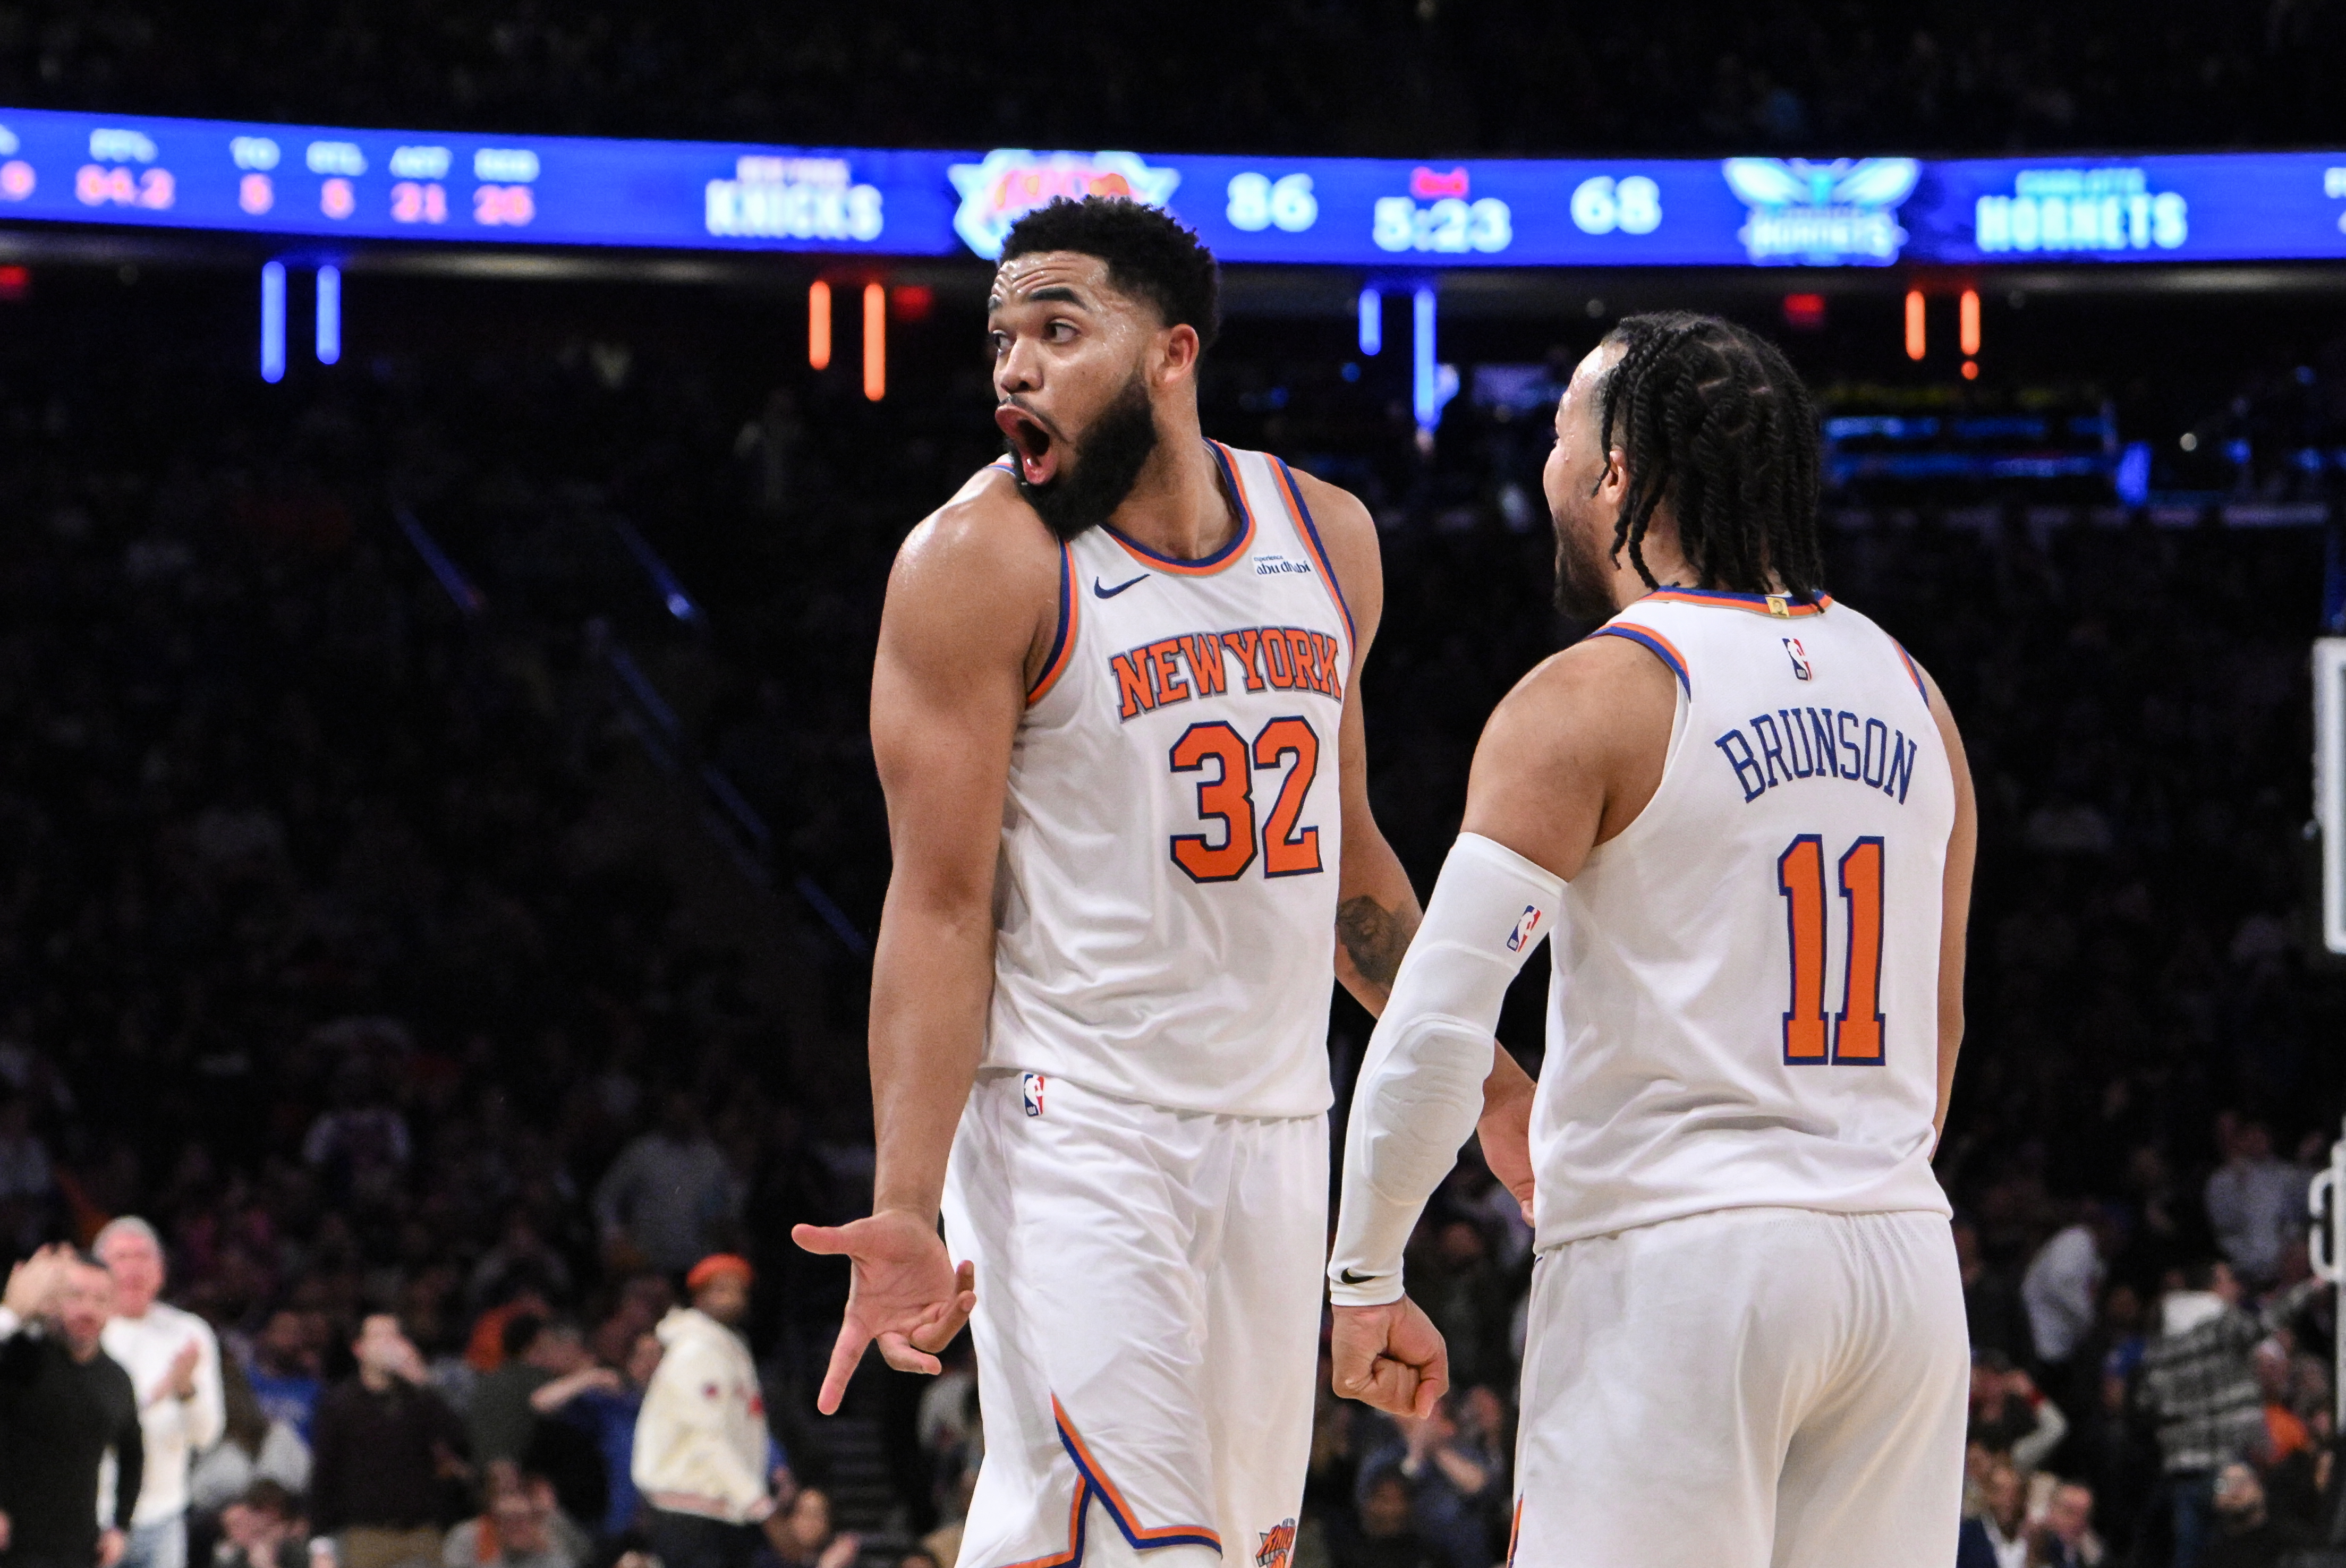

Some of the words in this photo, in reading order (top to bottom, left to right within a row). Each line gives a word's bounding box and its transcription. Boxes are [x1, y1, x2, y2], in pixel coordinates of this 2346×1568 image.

[706, 178, 882, 242] KNICKS
[1226, 172, 1318, 232] 86
[1373, 196, 1512, 254] 5:23
[1570, 175, 1663, 235] 68
[1976, 192, 2187, 252] HORNETS
[1257, 563, 1280, 575] abu
[1110, 631, 1228, 723] NEW
[1221, 626, 1342, 704] YORK
[1714, 708, 1917, 805] BRUNSON
[1169, 715, 1324, 884] 32
[1777, 833, 1885, 1066] 11
